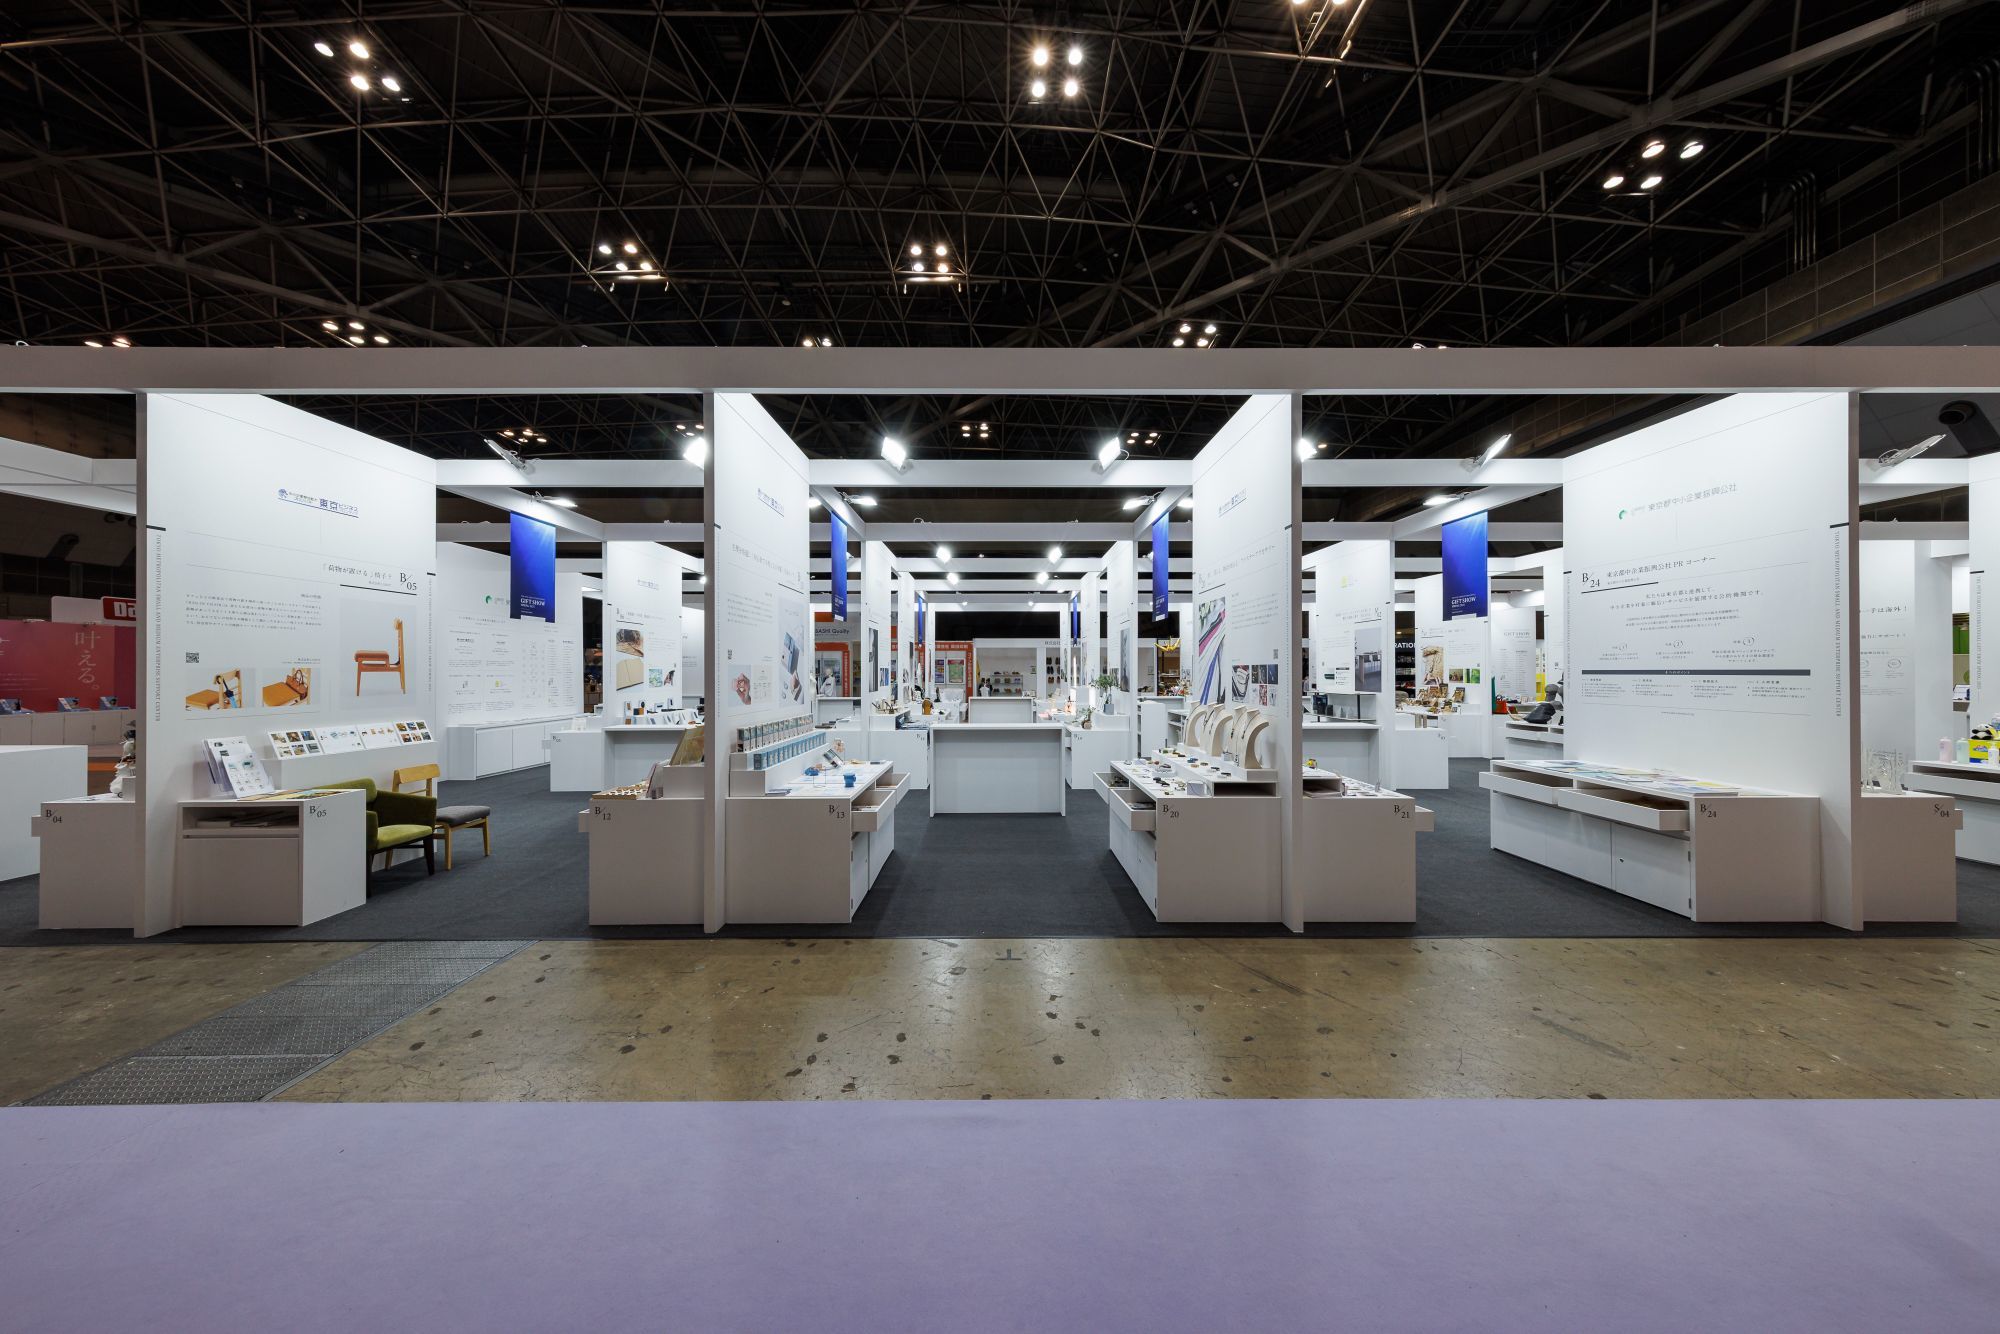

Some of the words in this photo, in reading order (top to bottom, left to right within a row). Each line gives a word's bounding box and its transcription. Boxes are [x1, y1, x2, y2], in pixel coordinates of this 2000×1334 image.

[1648, 483, 1737, 511] 東京都中小企業振興公社
[323, 563, 392, 580] 「荷物が置ける」椅子
[1673, 560, 1684, 568] PR
[1686, 556, 1716, 564] コーナー
[75, 630, 101, 689] 叶える。
